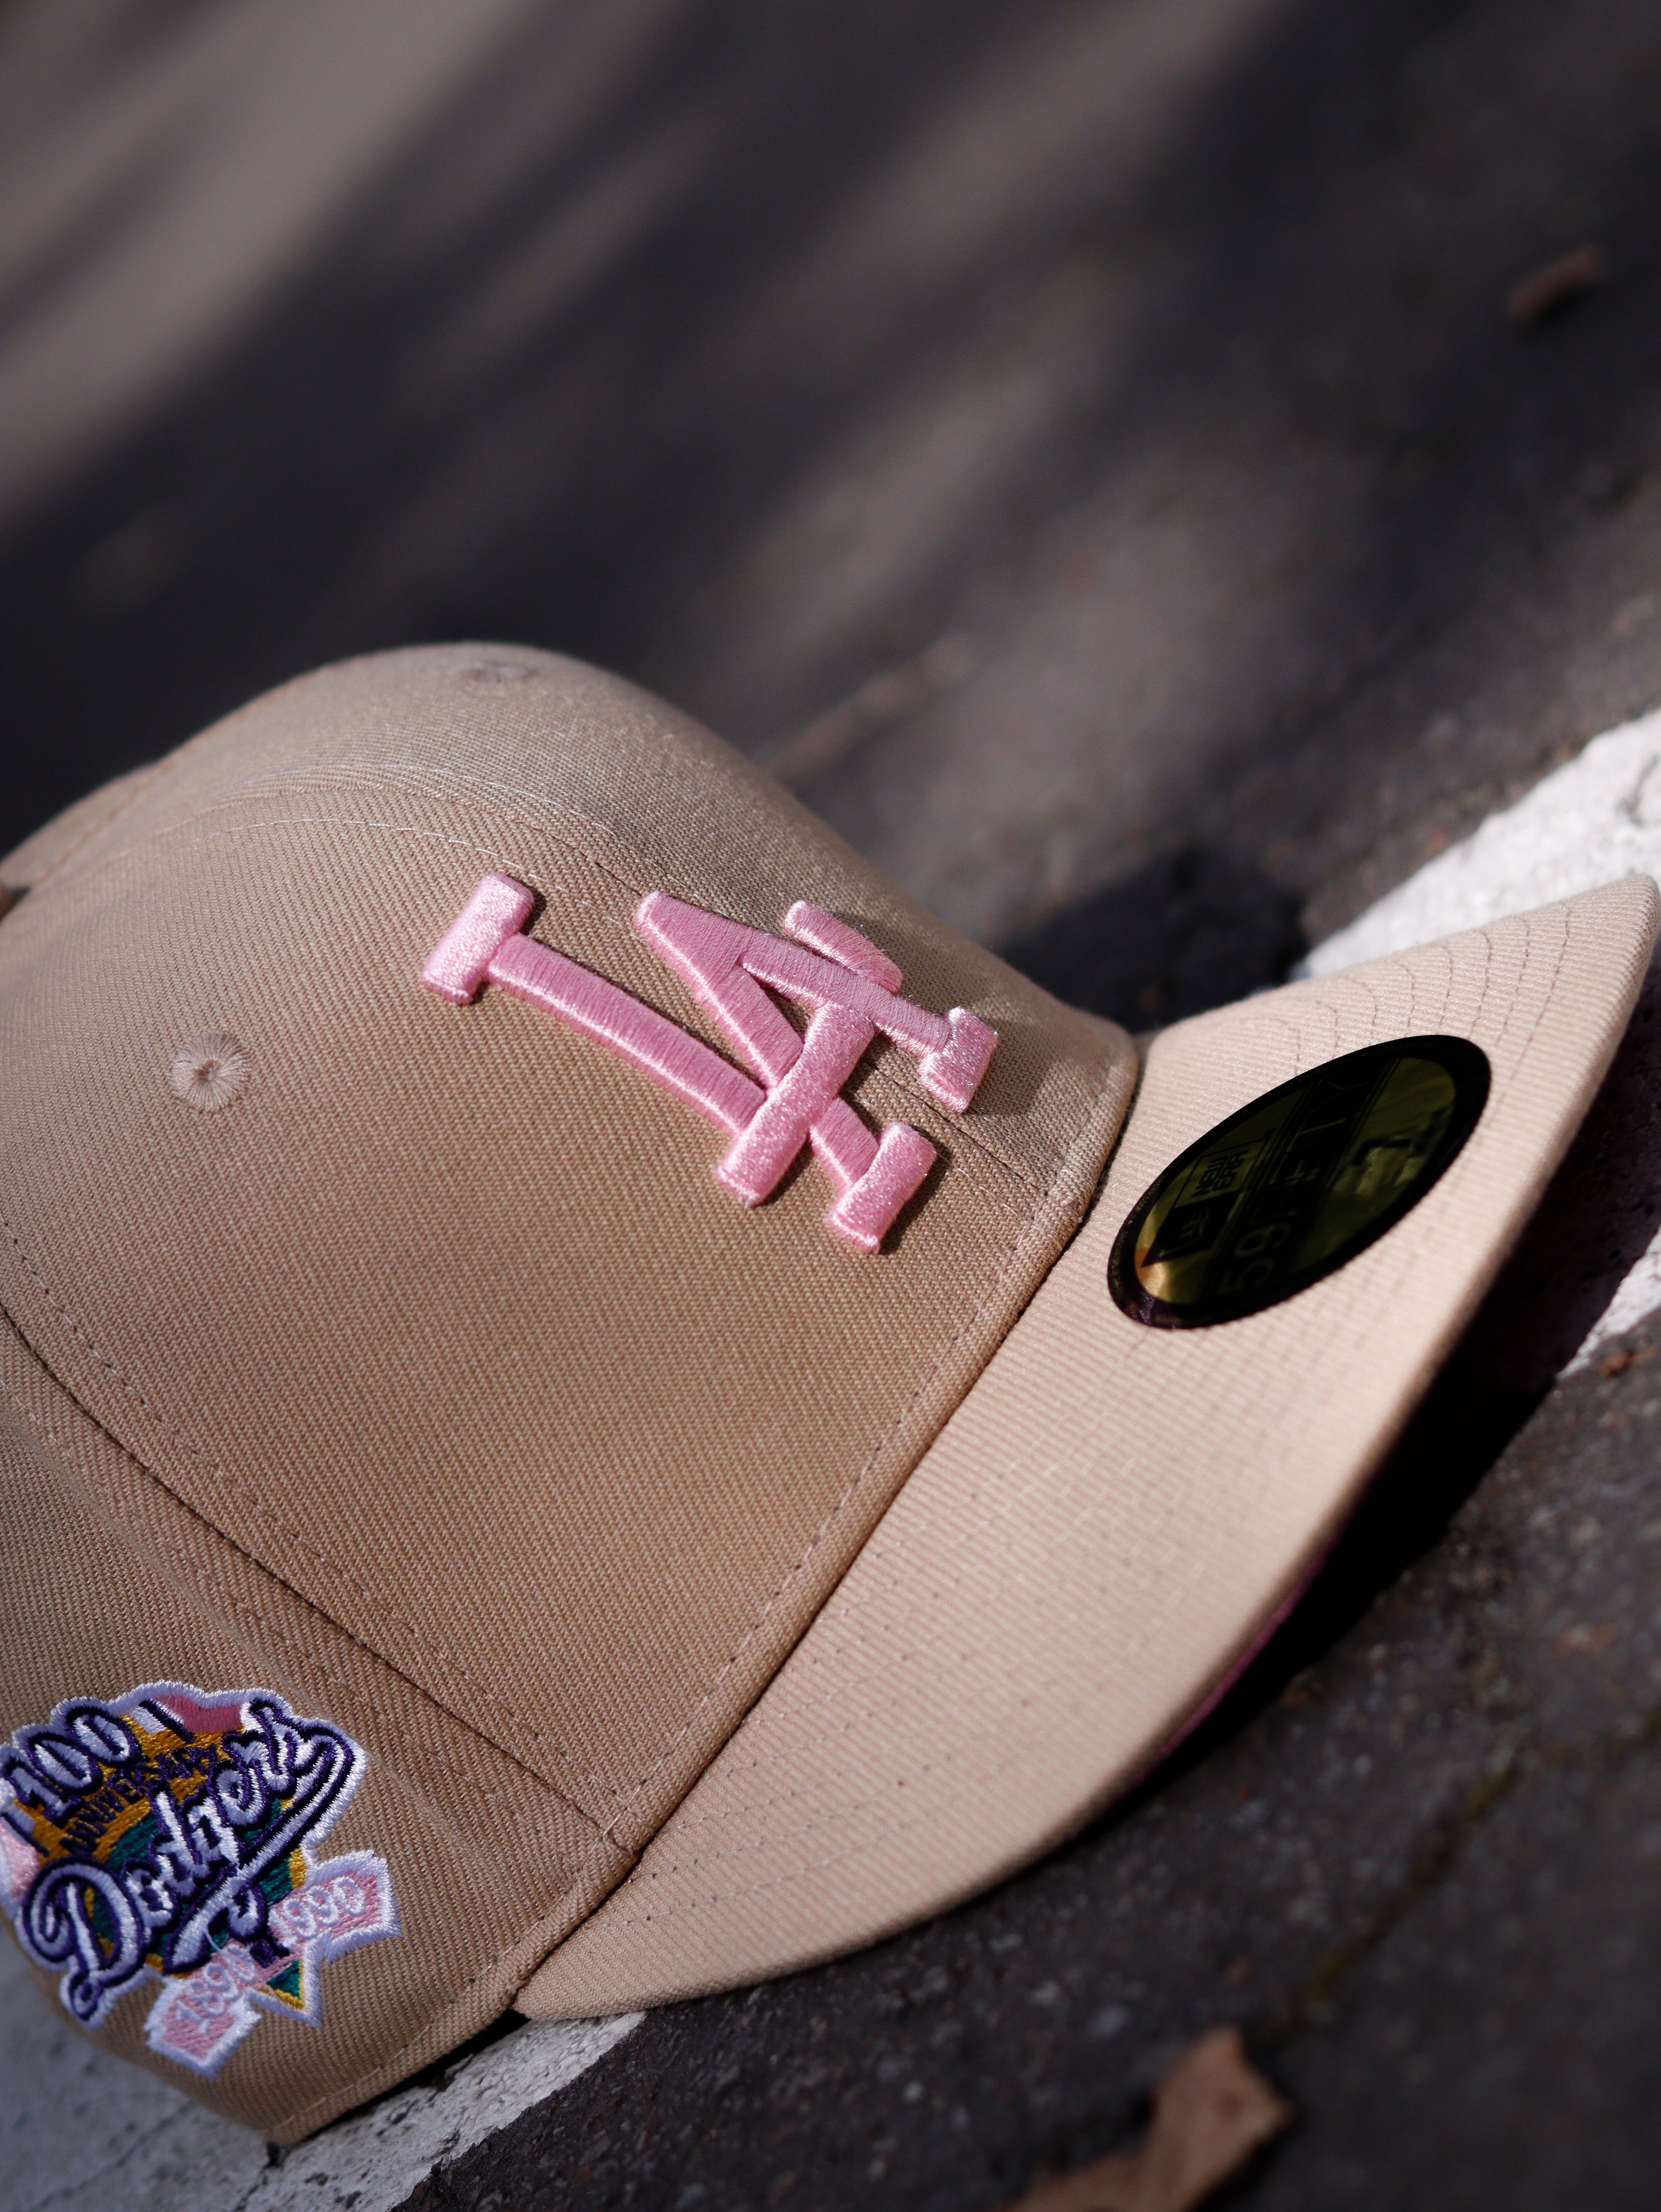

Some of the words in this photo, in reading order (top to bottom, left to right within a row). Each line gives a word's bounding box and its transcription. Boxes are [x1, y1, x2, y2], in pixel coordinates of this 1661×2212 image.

[420, 871, 997, 1254] LA
[1192, 1153, 1226, 1198] NEW
[1212, 1148, 1250, 1193] ERA
[2, 1705, 141, 1824] 100
[23, 1698, 356, 2021] Dodgers
[268, 1876, 365, 1949] 1990
[176, 1943, 256, 2034] 1890
